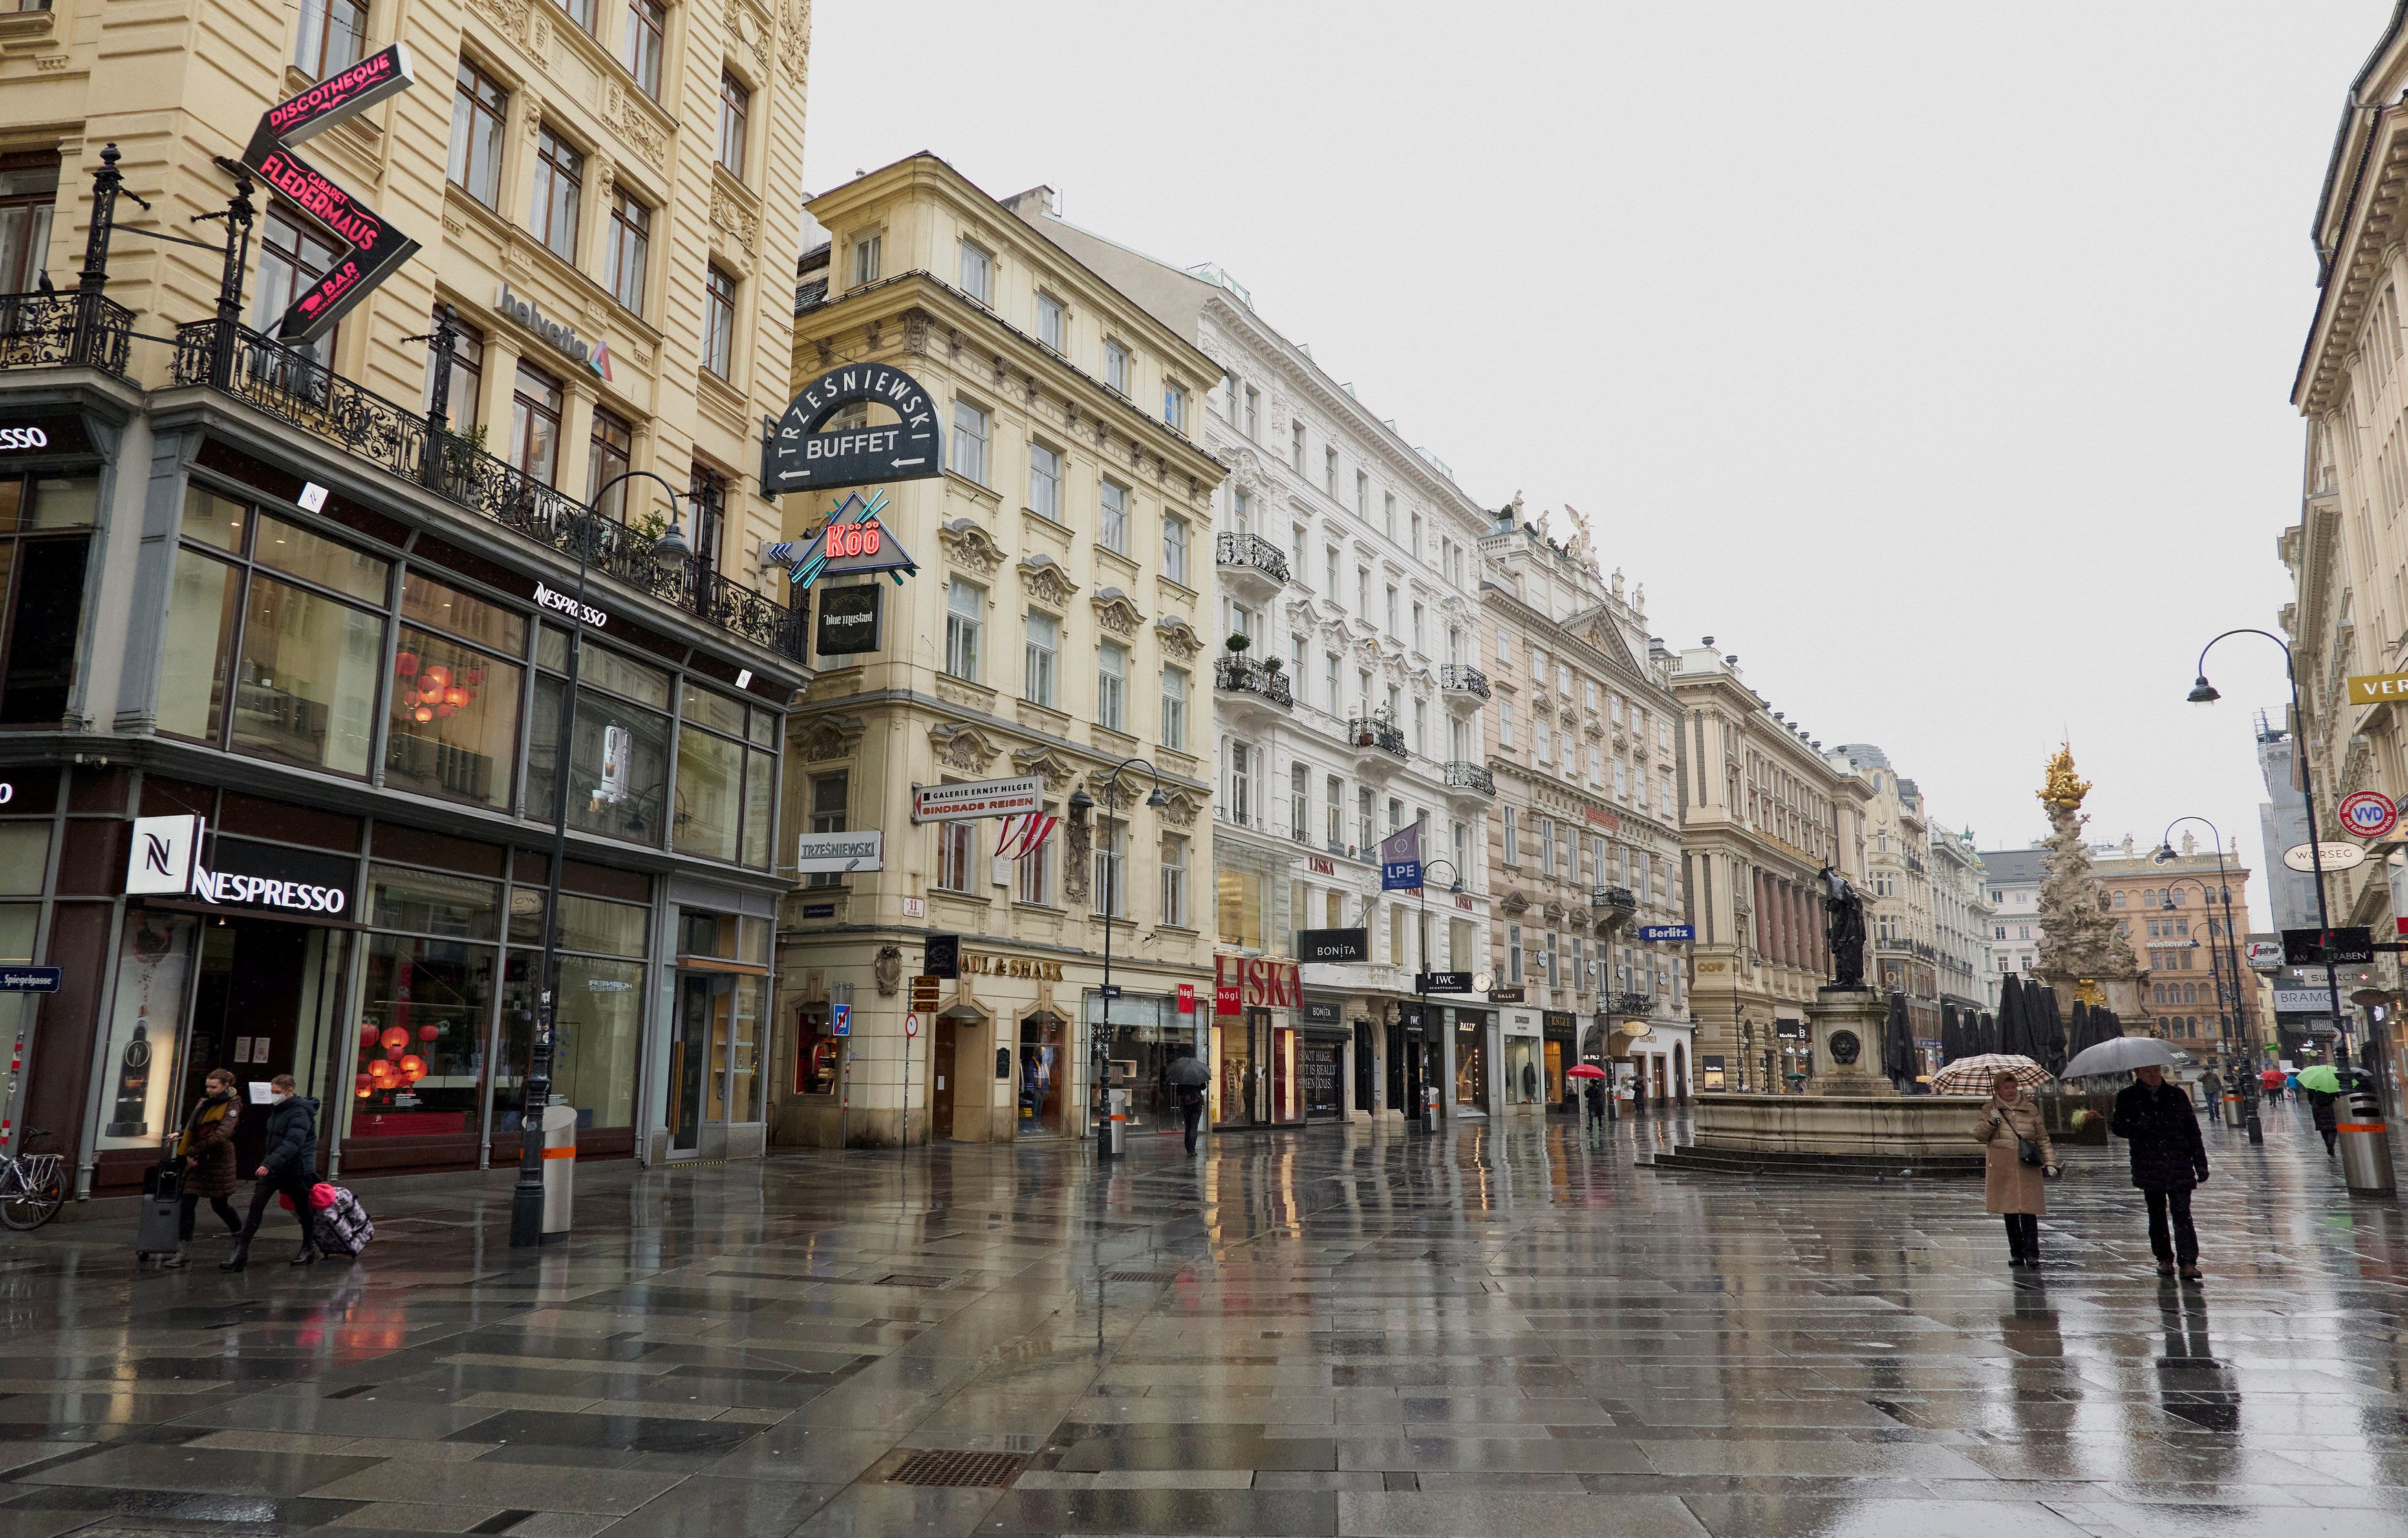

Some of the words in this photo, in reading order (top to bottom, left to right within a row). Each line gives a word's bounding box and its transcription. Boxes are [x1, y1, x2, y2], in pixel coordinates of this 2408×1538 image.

[270, 53, 389, 127] DISCOTHEQUE
[308, 172, 348, 205] CABARET
[260, 154, 378, 250] FLEDERMAUS
[321, 261, 357, 296] BAR
[495, 282, 588, 363] helvetia
[806, 430, 899, 459] BUFFET
[824, 614, 841, 625] blue
[842, 611, 873, 626] mustard
[933, 790, 969, 799] GALERIE
[971, 786, 999, 795] ERNST
[1001, 783, 1033, 792] HILGER
[923, 803, 985, 815] SINDBADS
[989, 797, 1033, 810] REISEN
[2342, 794, 2394, 814] Versicherungsdienst
[2353, 806, 2384, 822] VVD
[2343, 816, 2352, 827] mit
[802, 842, 875, 856] TRZEŚNIEWSKI
[1309, 856, 1335, 876] LISKA
[1388, 865, 1415, 878] LPE
[196, 865, 345, 913] NESPRESSO
[910, 899, 917, 911] 11
[1455, 896, 1473, 911] LISKA
[1648, 927, 1688, 938] Berlitz
[2250, 944, 2279, 957] Segafredo
[2333, 952, 2367, 960] RABEN
[961, 955, 992, 974] AUL
[994, 958, 1007, 975] &
[1009, 960, 1064, 981] SHARK
[4, 974, 52, 986] Spiegelgasse
[1436, 975, 1455, 984] IWC
[2311, 973, 2360, 982] swtch
[1410, 1016, 1420, 1026] IWC
[1459, 1022, 1476, 1032] BALLY
[1551, 1015, 1571, 1027] KNIZE
[1304, 1050, 1315, 1061] NOT
[1315, 1050, 1332, 1061] HUGE,
[1310, 1064, 1315, 1074] IS
[1316, 1064, 1336, 1075] REALLY
